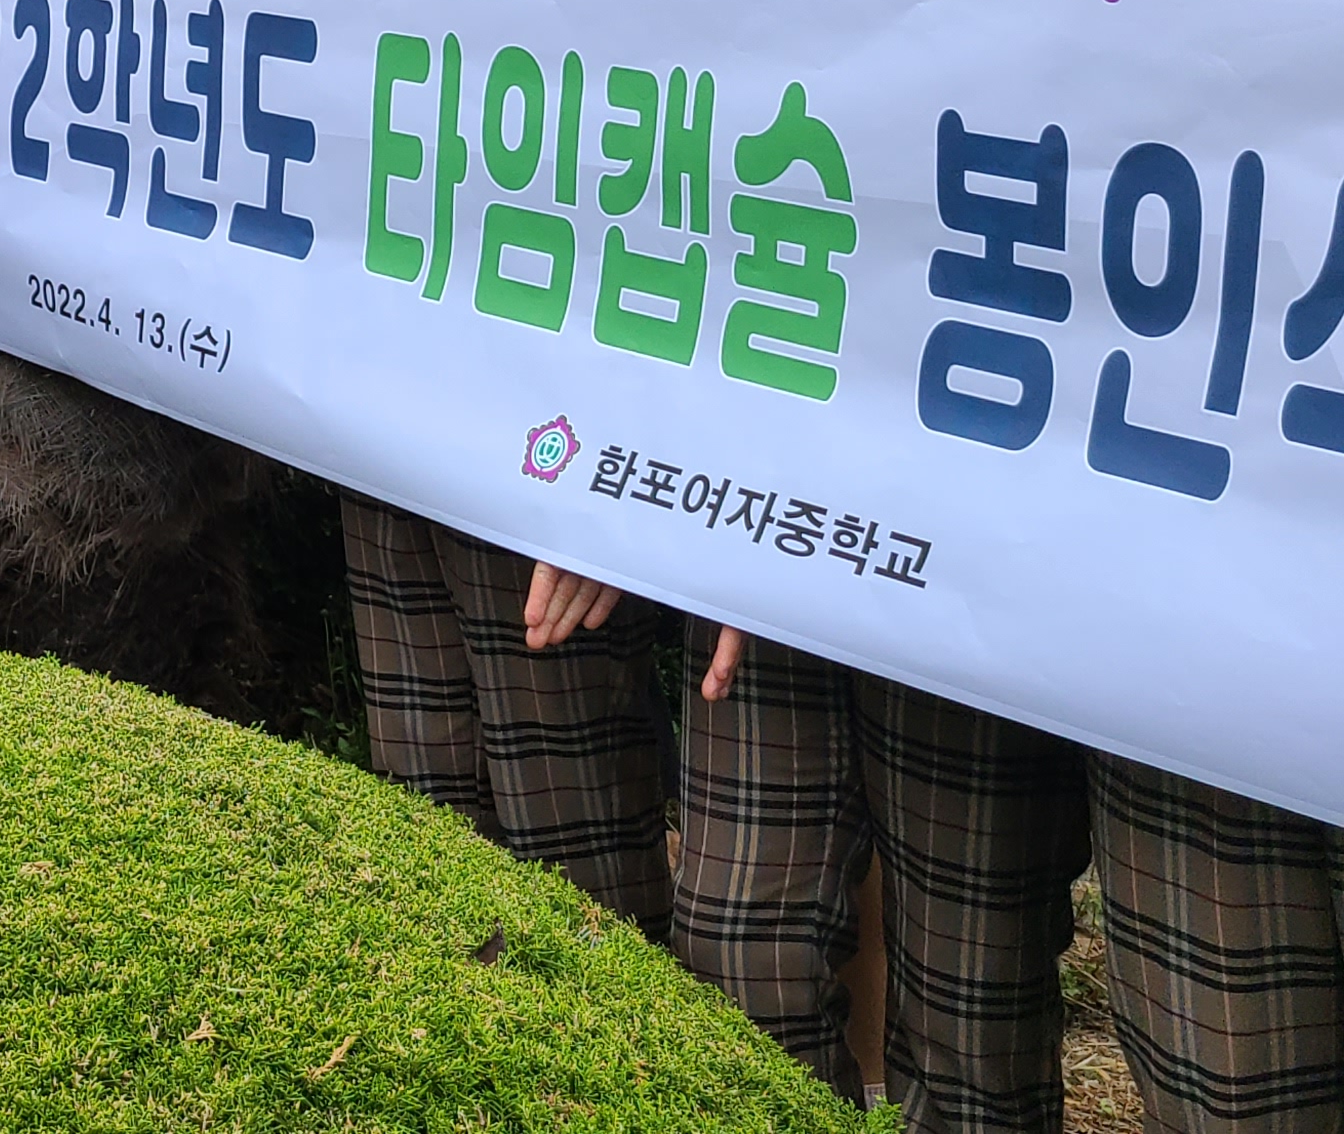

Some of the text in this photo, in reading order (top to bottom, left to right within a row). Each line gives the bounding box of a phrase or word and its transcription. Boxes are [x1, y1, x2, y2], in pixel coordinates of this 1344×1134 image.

[365, 33, 858, 400] 타임캡슐
[28, 274, 231, 373] 2022.4. 13.(수)
[588, 445, 933, 589] 합포여자중학교
